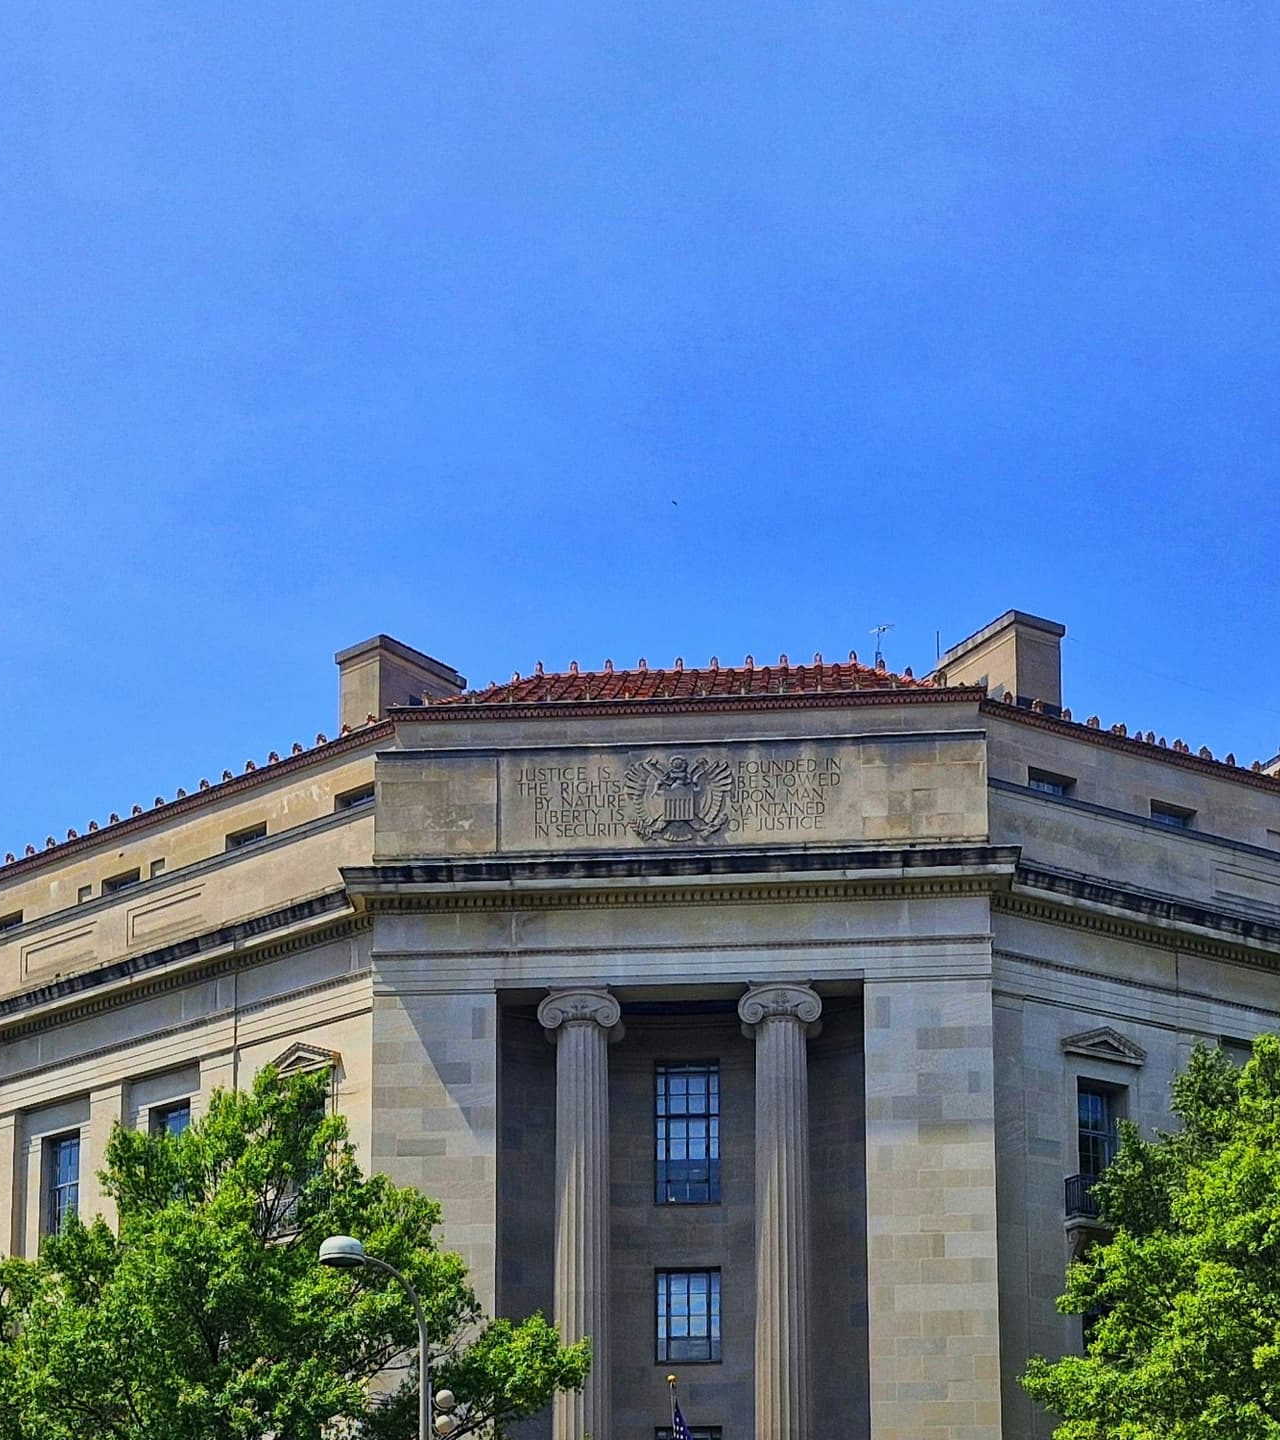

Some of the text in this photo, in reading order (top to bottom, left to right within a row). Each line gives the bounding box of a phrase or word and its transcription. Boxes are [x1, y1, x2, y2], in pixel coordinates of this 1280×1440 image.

[516, 758, 841, 782] JUSTICE IS FOUNDED IN
[517, 772, 841, 797] THE RIGHTS BESTOWED
[535, 796, 552, 810] BY
[561, 794, 628, 809] NATURE
[730, 788, 776, 803] UPON
[534, 801, 826, 824] LIBERTY IS MAINTAINED
[534, 824, 549, 838] IN
[556, 822, 629, 838] SECURITY
[727, 818, 751, 832] OF
